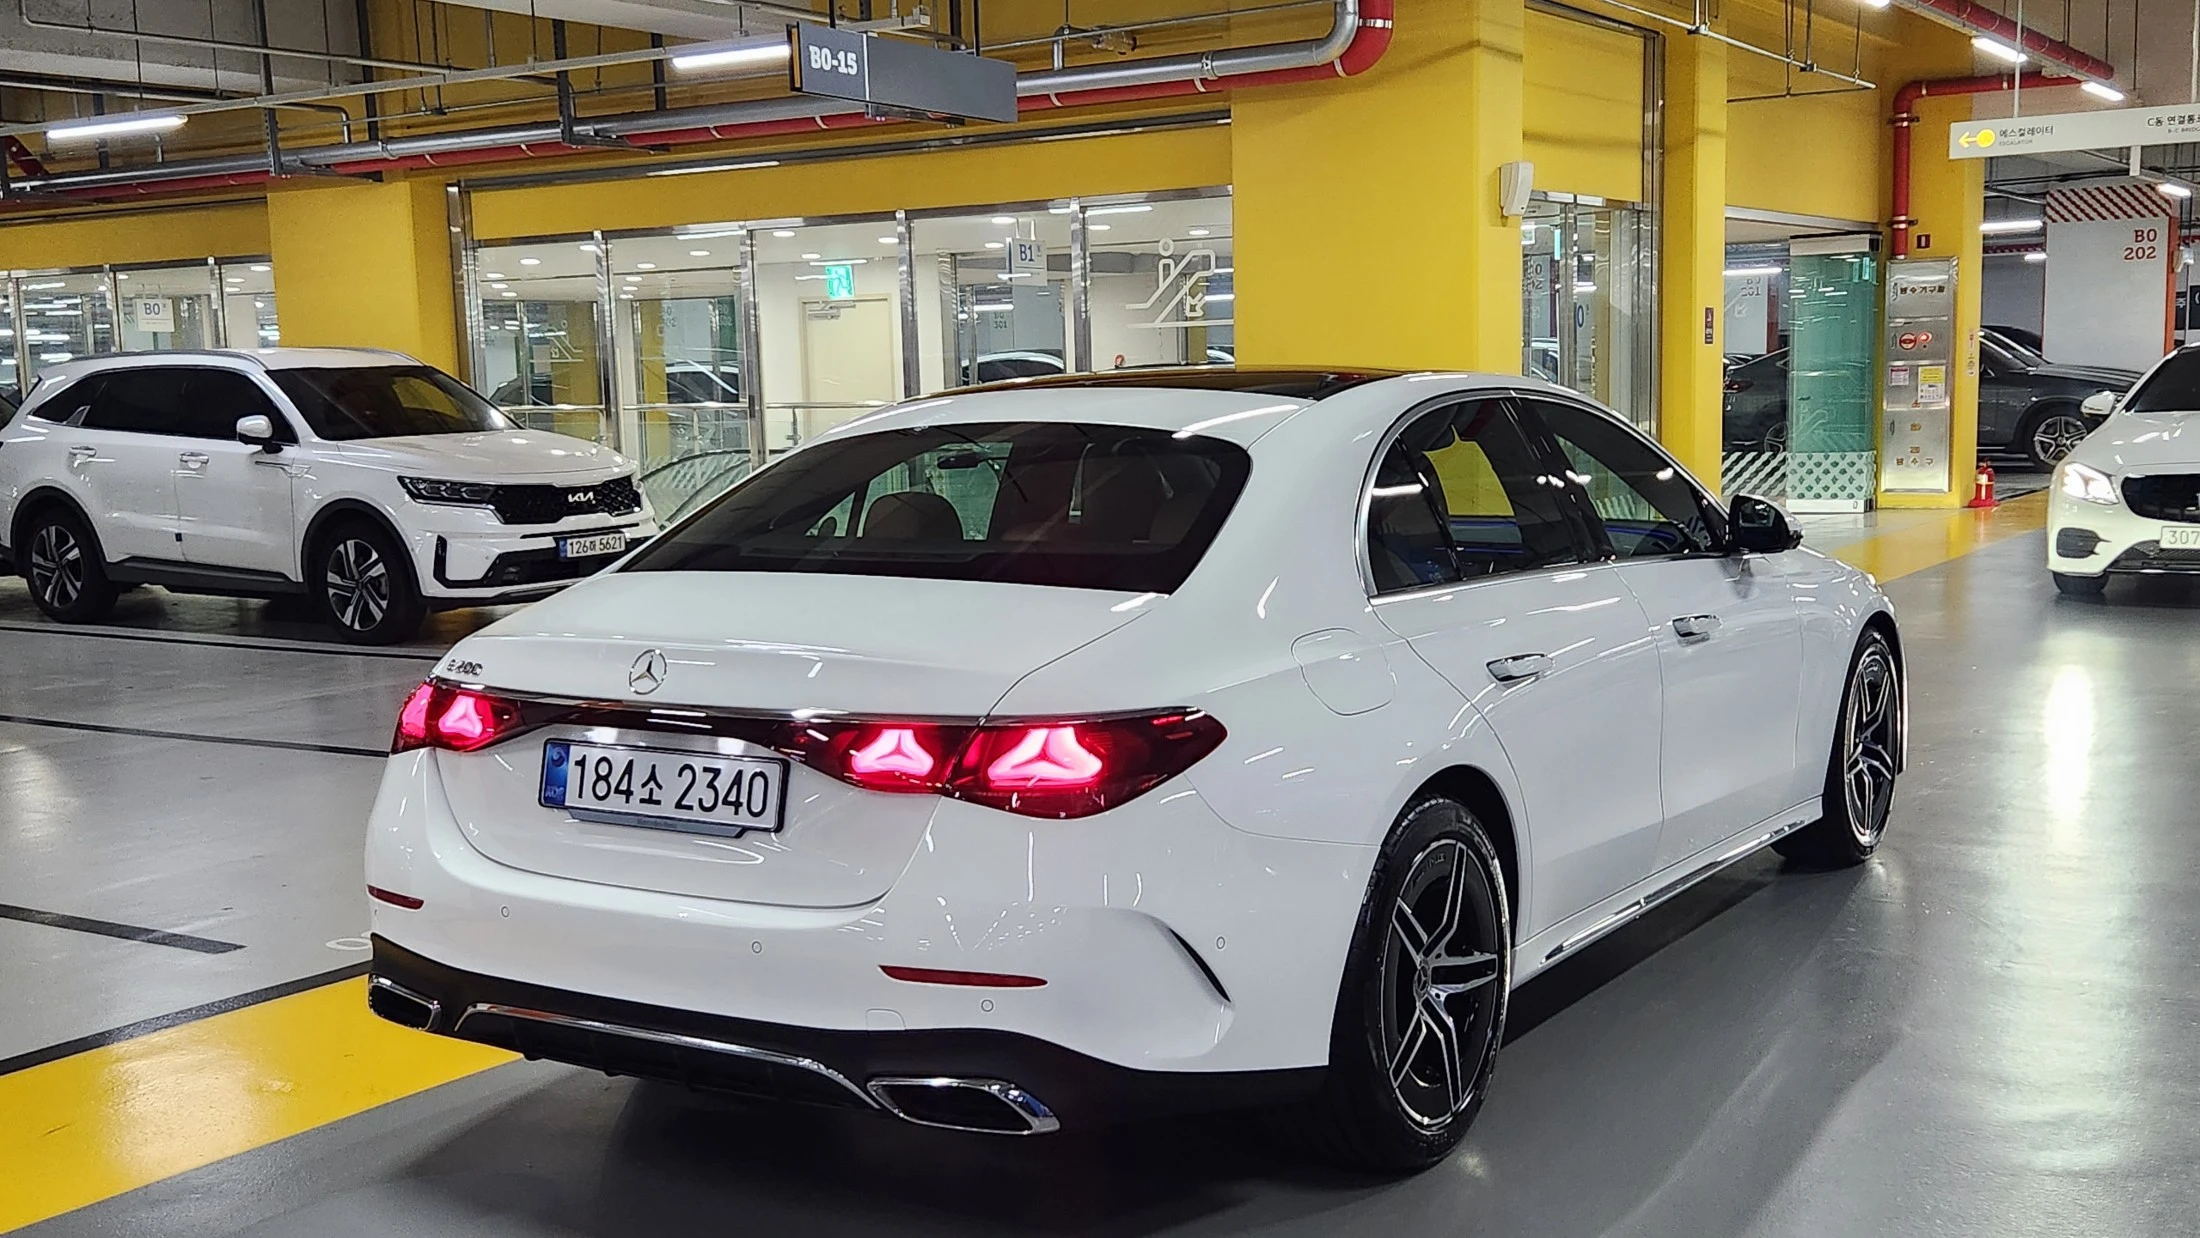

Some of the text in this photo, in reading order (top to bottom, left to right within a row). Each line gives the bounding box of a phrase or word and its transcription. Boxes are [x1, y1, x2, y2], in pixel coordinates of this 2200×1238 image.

[2147, 116, 2164, 127] C동
[1999, 125, 2054, 138] 에스컬레이터
[1019, 243, 1035, 262] B1
[2123, 246, 2156, 260] 202
[599, 535, 622, 552] 5621
[573, 753, 770, 818] 184소 2340
